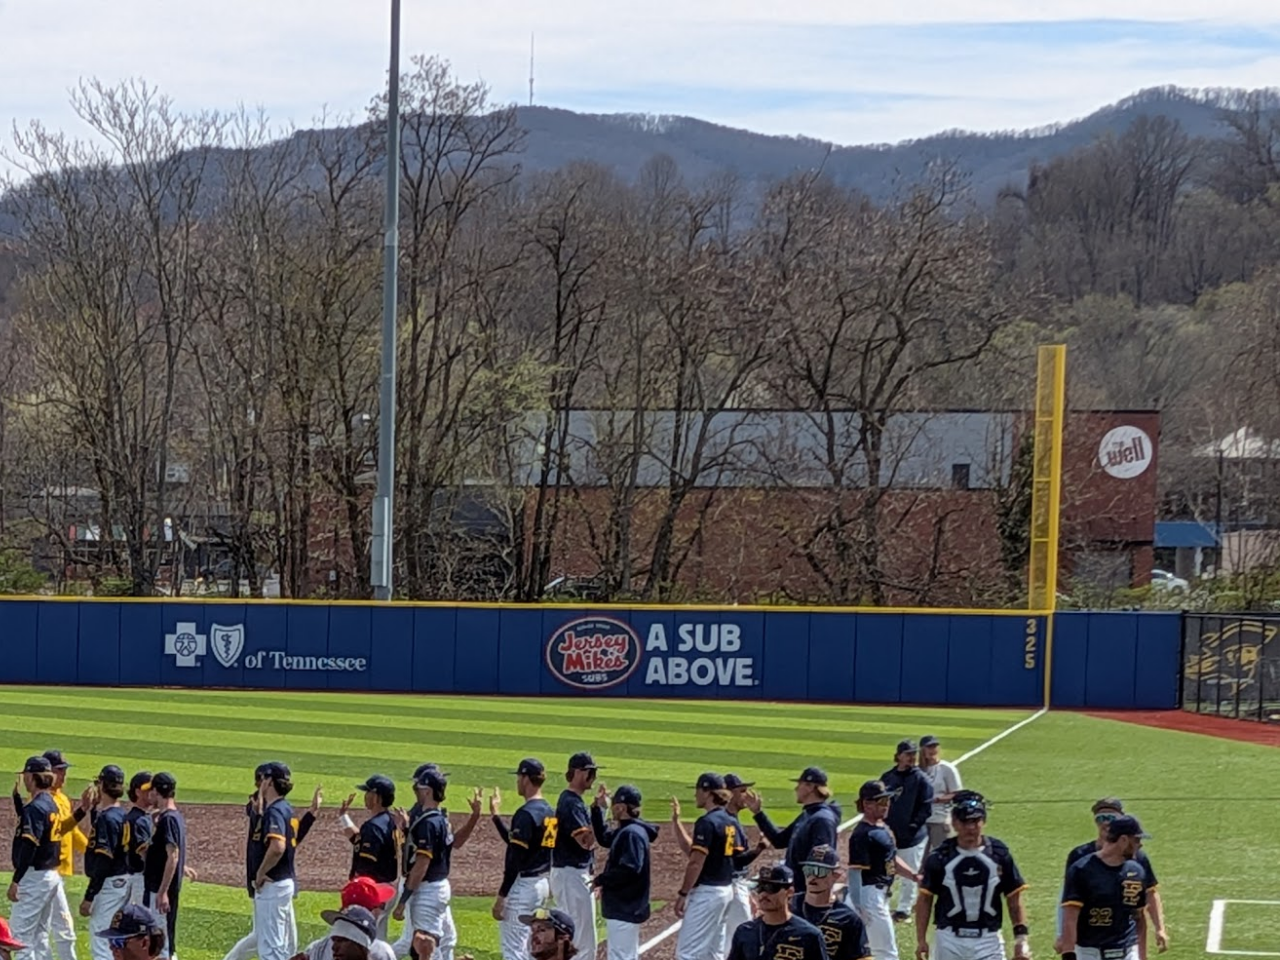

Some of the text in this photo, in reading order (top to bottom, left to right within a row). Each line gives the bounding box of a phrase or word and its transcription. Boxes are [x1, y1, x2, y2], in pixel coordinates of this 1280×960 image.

[1106, 435, 1145, 467] well
[558, 631, 629, 655] Jersey
[645, 623, 741, 653] A SUB
[1024, 618, 1038, 669] 325
[244, 651, 367, 671] of Tennessee
